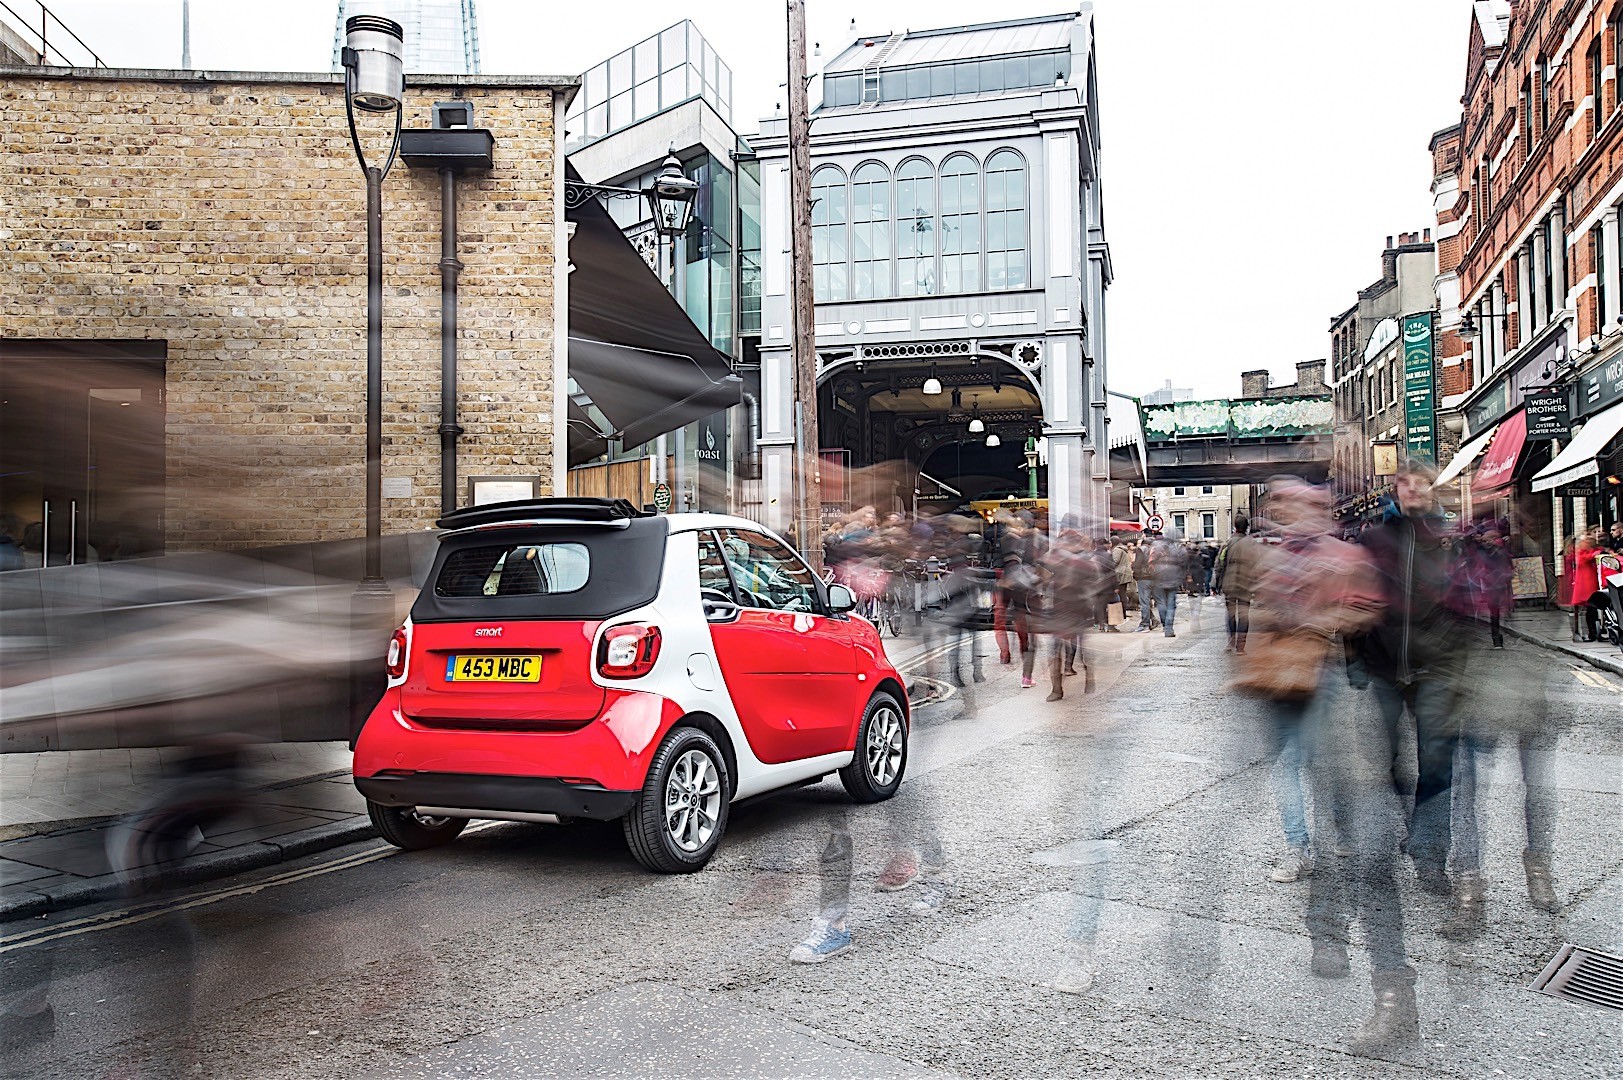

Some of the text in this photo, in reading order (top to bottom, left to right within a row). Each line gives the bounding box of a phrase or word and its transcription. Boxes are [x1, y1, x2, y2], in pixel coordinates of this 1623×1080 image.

[1409, 322, 1423, 330] THE
[1531, 398, 1562, 406] WRIGHT
[1527, 405, 1567, 414] BROTHERS
[694, 449, 720, 460] roast
[474, 626, 502, 636] smart
[462, 658, 532, 677] 453 MBC
